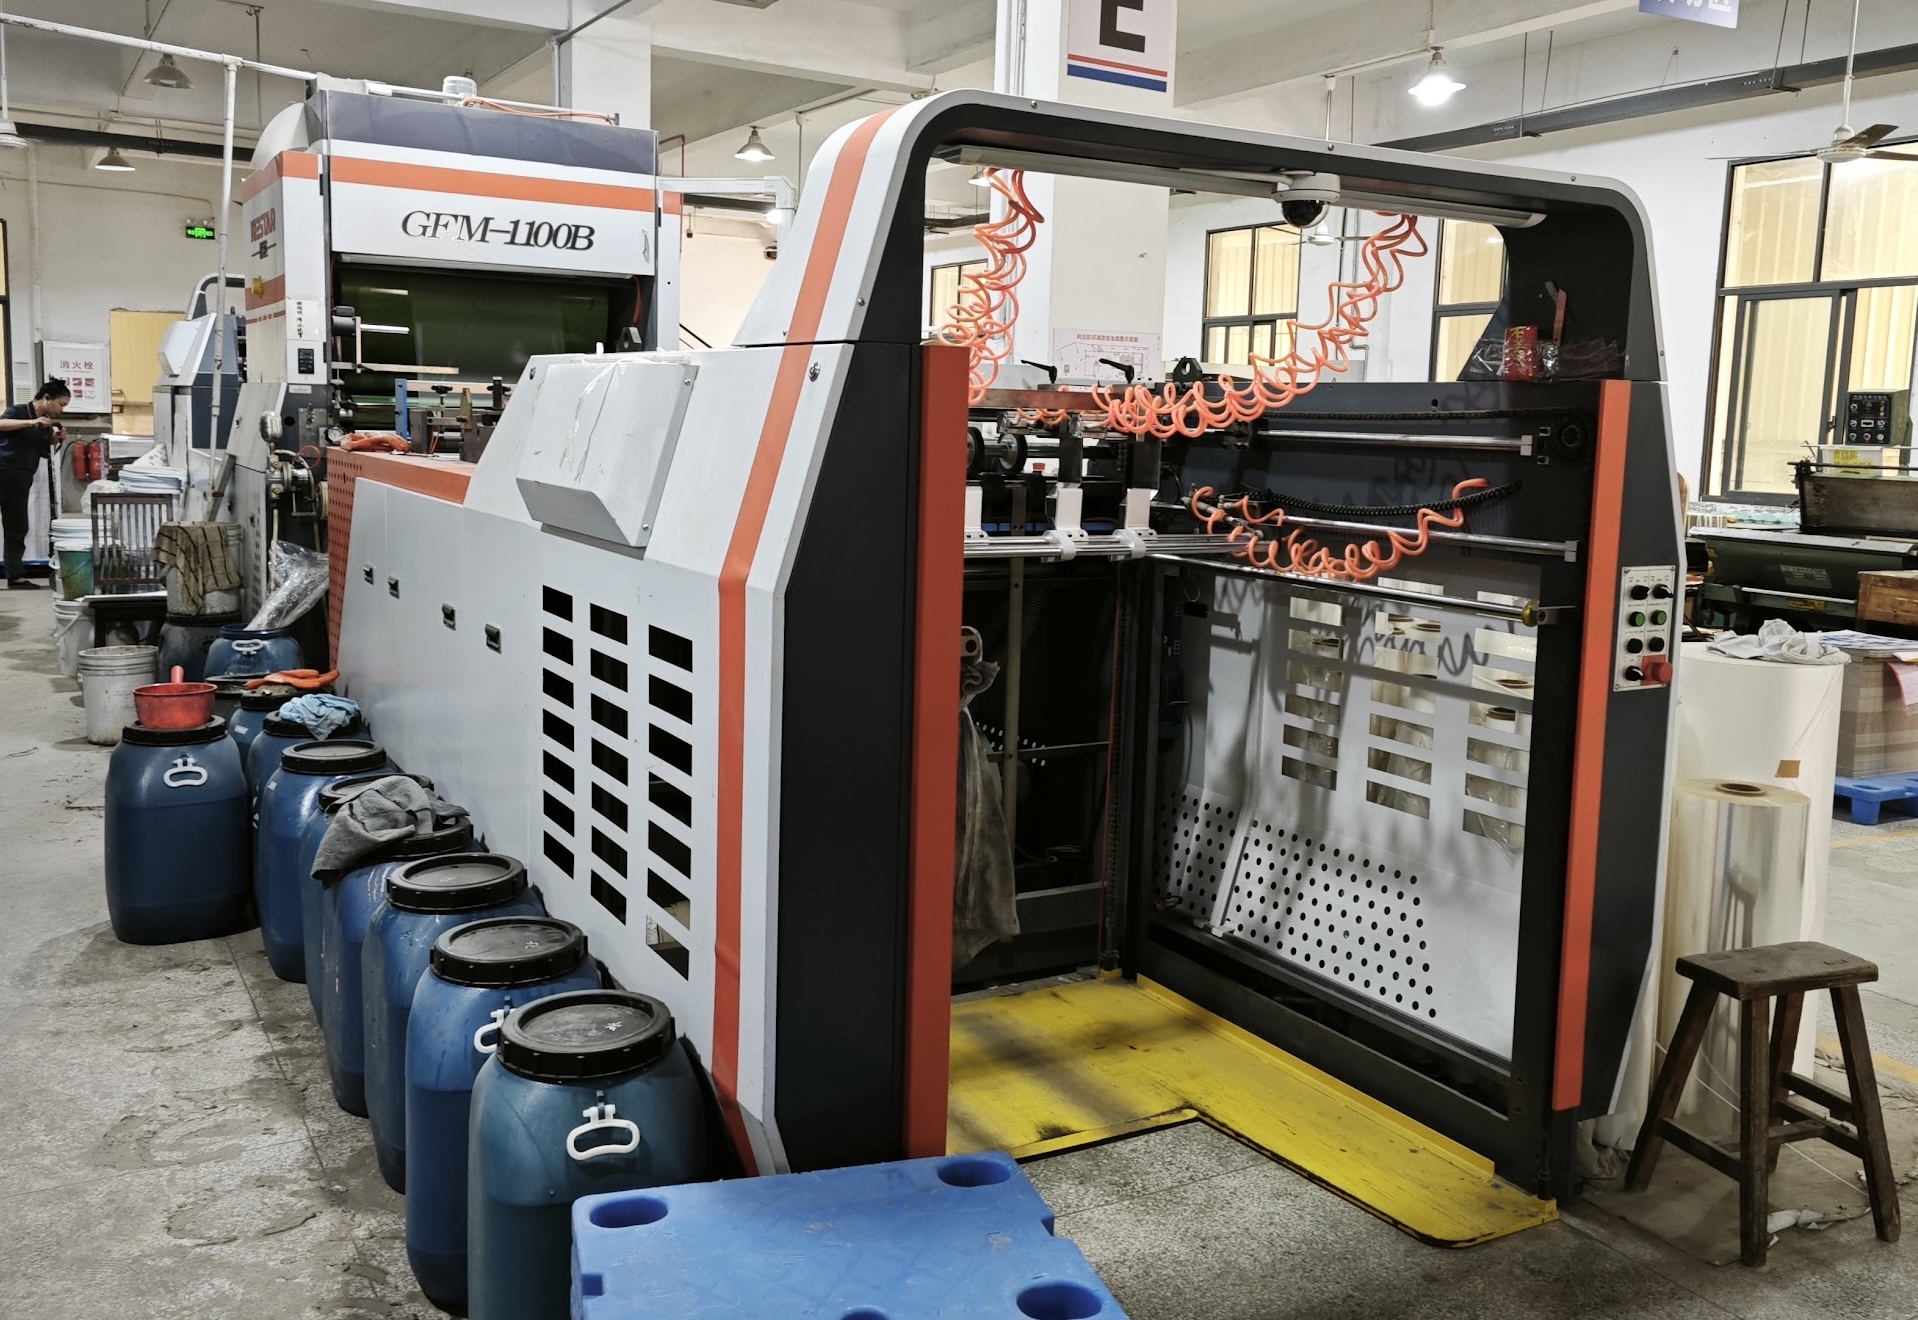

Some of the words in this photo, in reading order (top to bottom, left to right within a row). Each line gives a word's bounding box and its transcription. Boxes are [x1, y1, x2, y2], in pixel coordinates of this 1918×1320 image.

[1099, 0, 1146, 53] E
[401, 210, 595, 251] GFM-1100B
[60, 360, 94, 370] 消火栓
